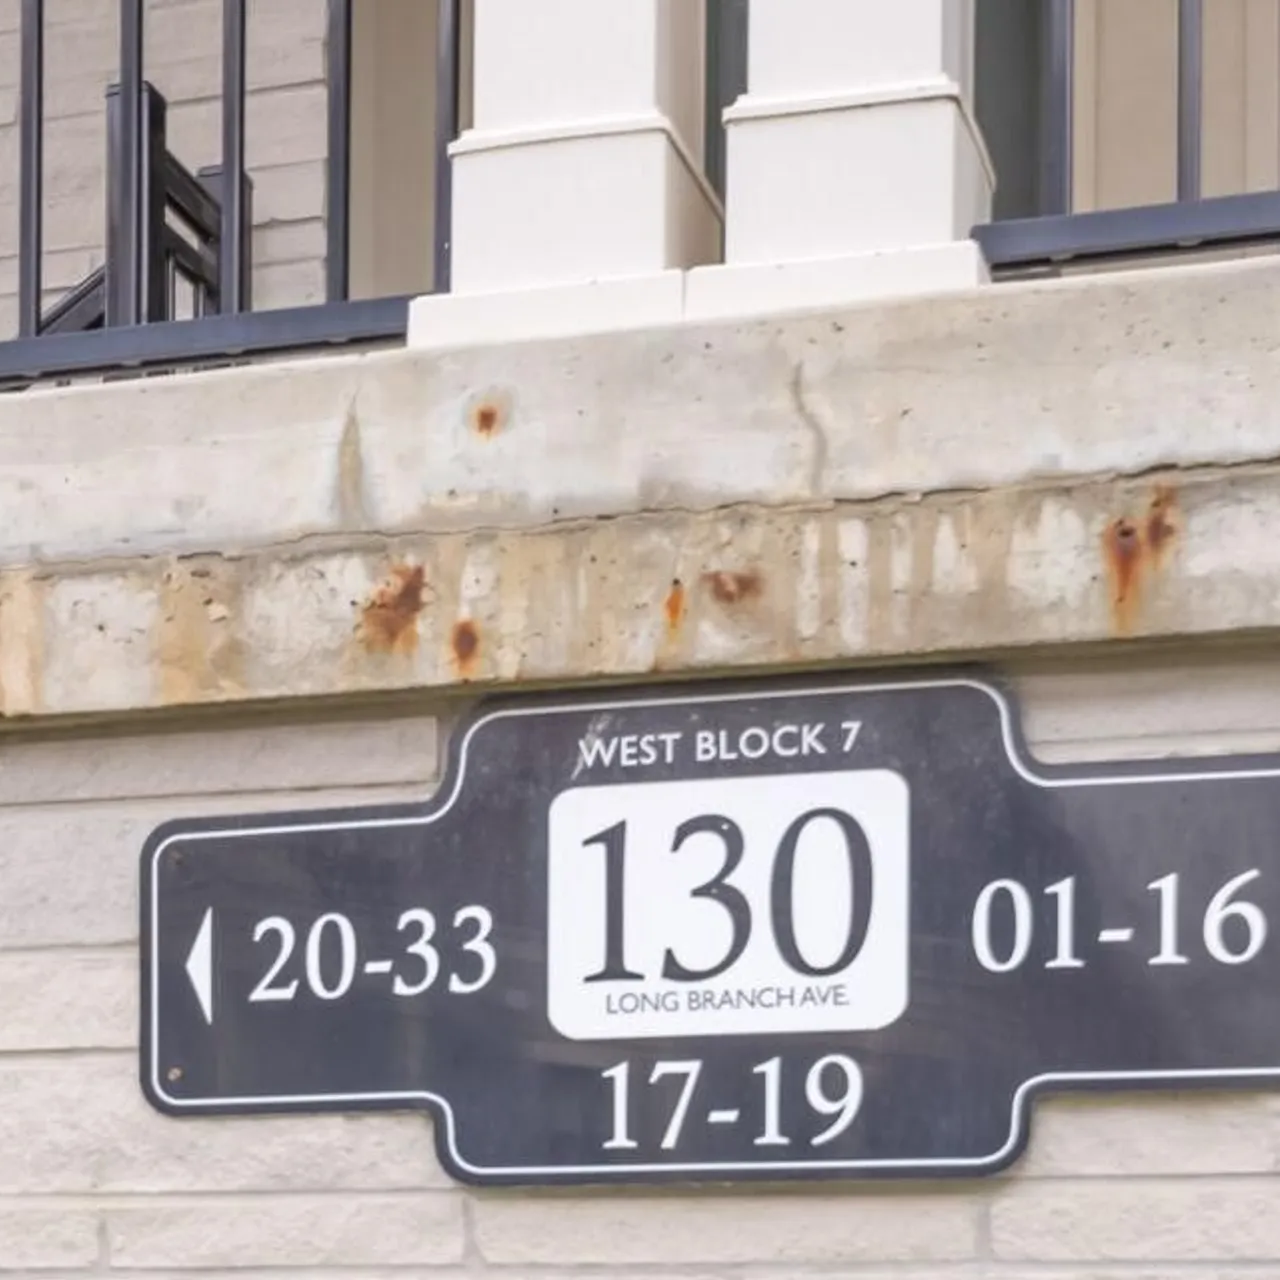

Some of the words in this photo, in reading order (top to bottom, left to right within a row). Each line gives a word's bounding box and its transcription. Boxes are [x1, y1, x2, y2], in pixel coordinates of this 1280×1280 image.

[578, 732, 681, 768] WEST
[696, 722, 825, 761] BLOCK
[841, 721, 862, 752] 7
[582, 806, 873, 984] 130
[972, 869, 1267, 972] 01-16
[248, 906, 497, 1001] 20-33
[606, 992, 679, 1014] LONG
[688, 988, 794, 1010] BRANCH
[601, 1055, 863, 1150] 17-19
